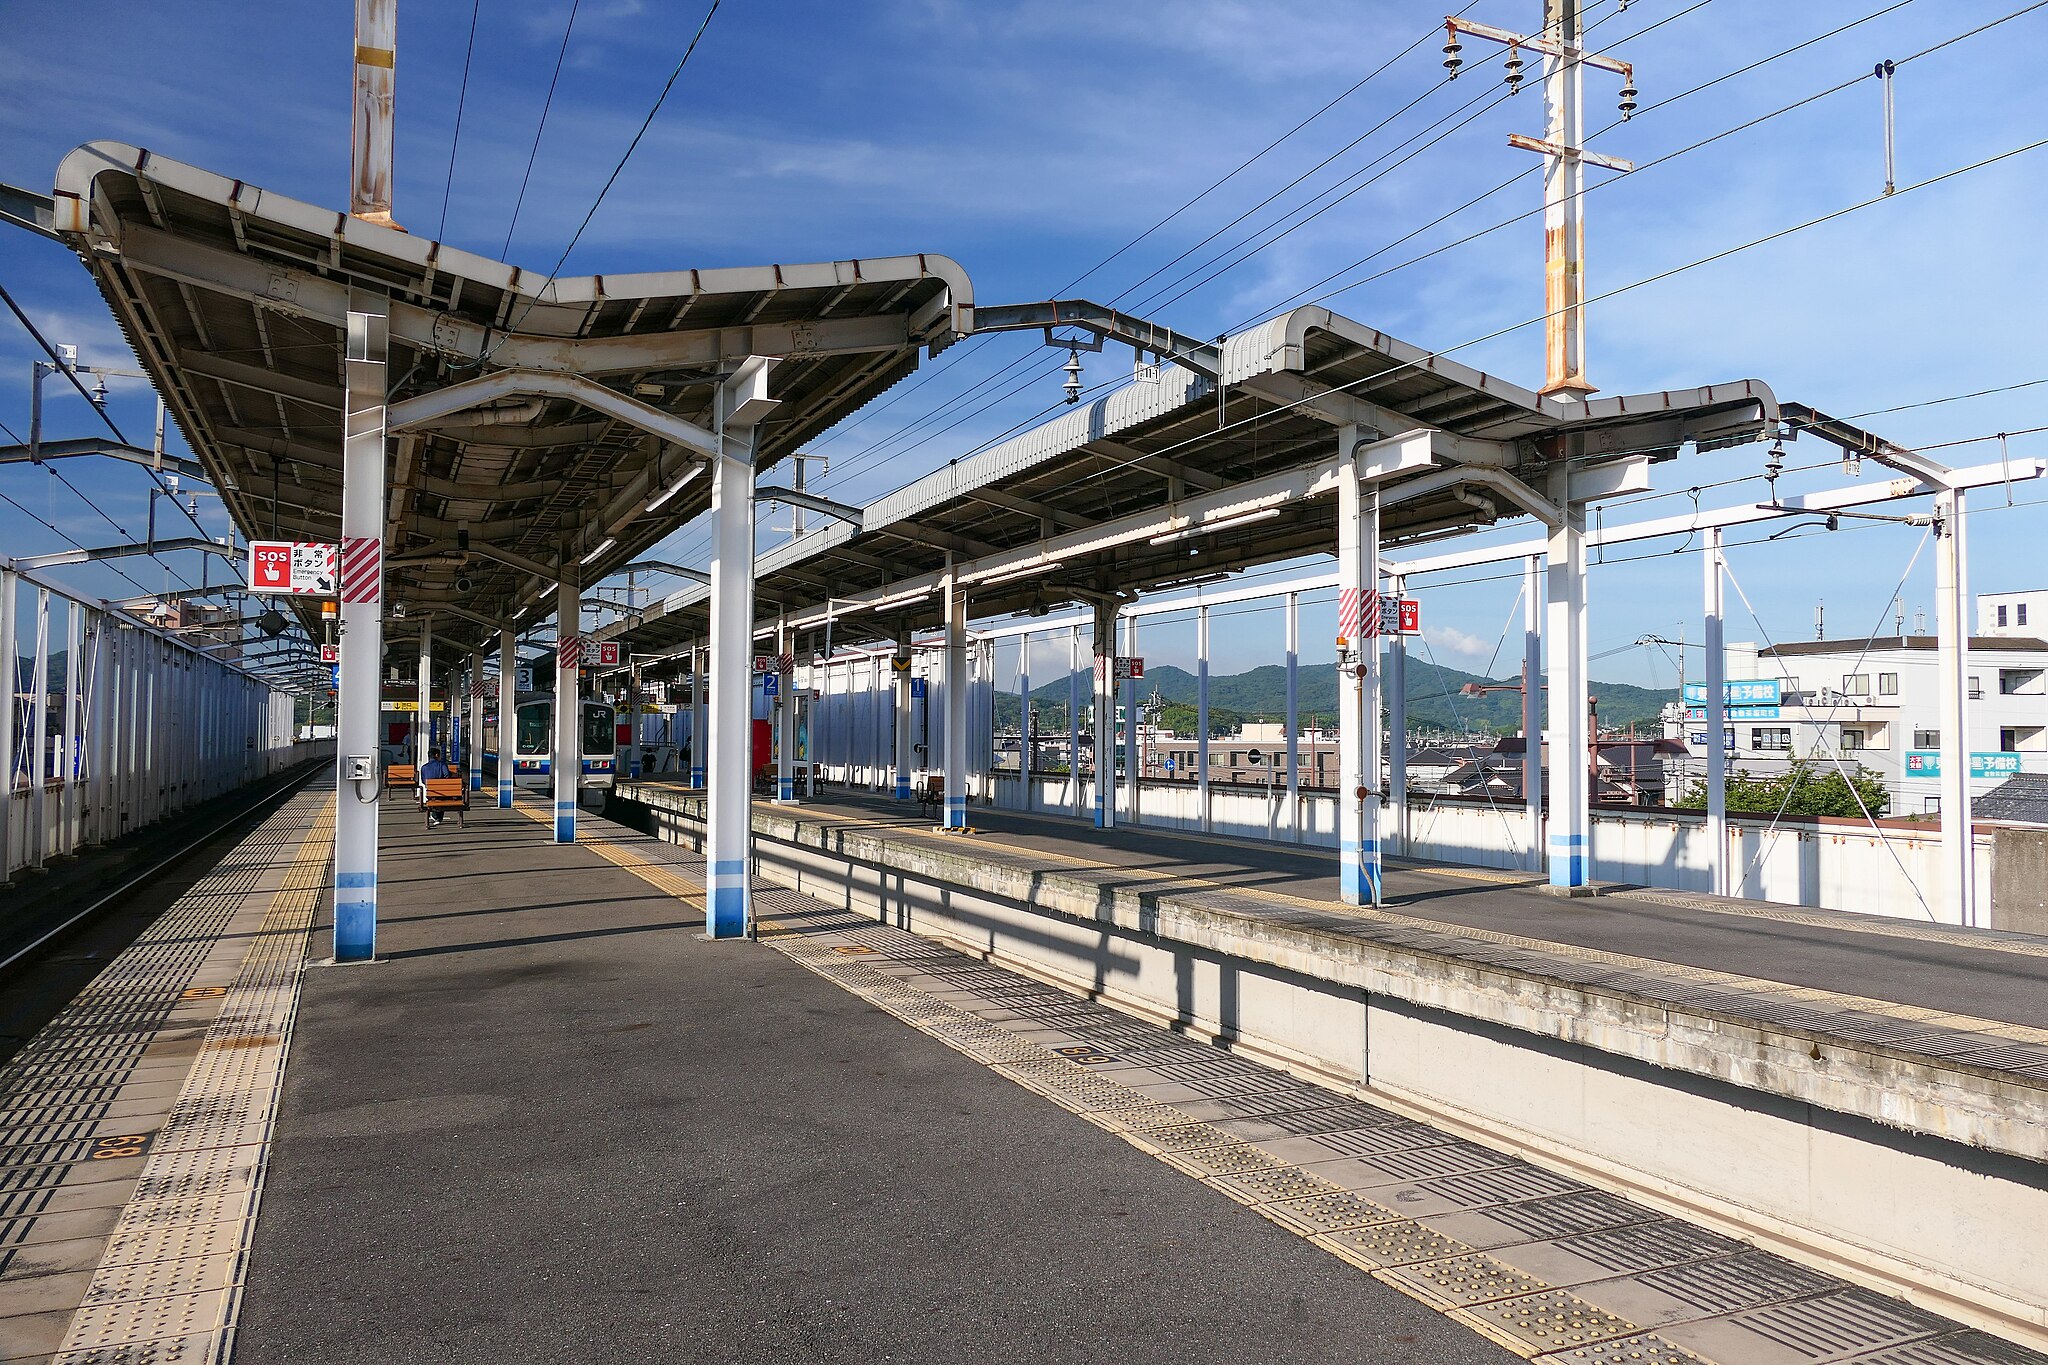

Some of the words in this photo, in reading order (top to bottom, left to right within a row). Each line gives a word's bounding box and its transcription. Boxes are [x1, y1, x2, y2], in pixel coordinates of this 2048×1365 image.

[258, 551, 287, 562] SOS
[293, 549, 323, 559] 非常
[293, 559, 323, 568] ボタン
[519, 669, 530, 684] 3
[766, 675, 776, 689] 2
[914, 678, 920, 691] 1
[592, 710, 606, 718] JR
